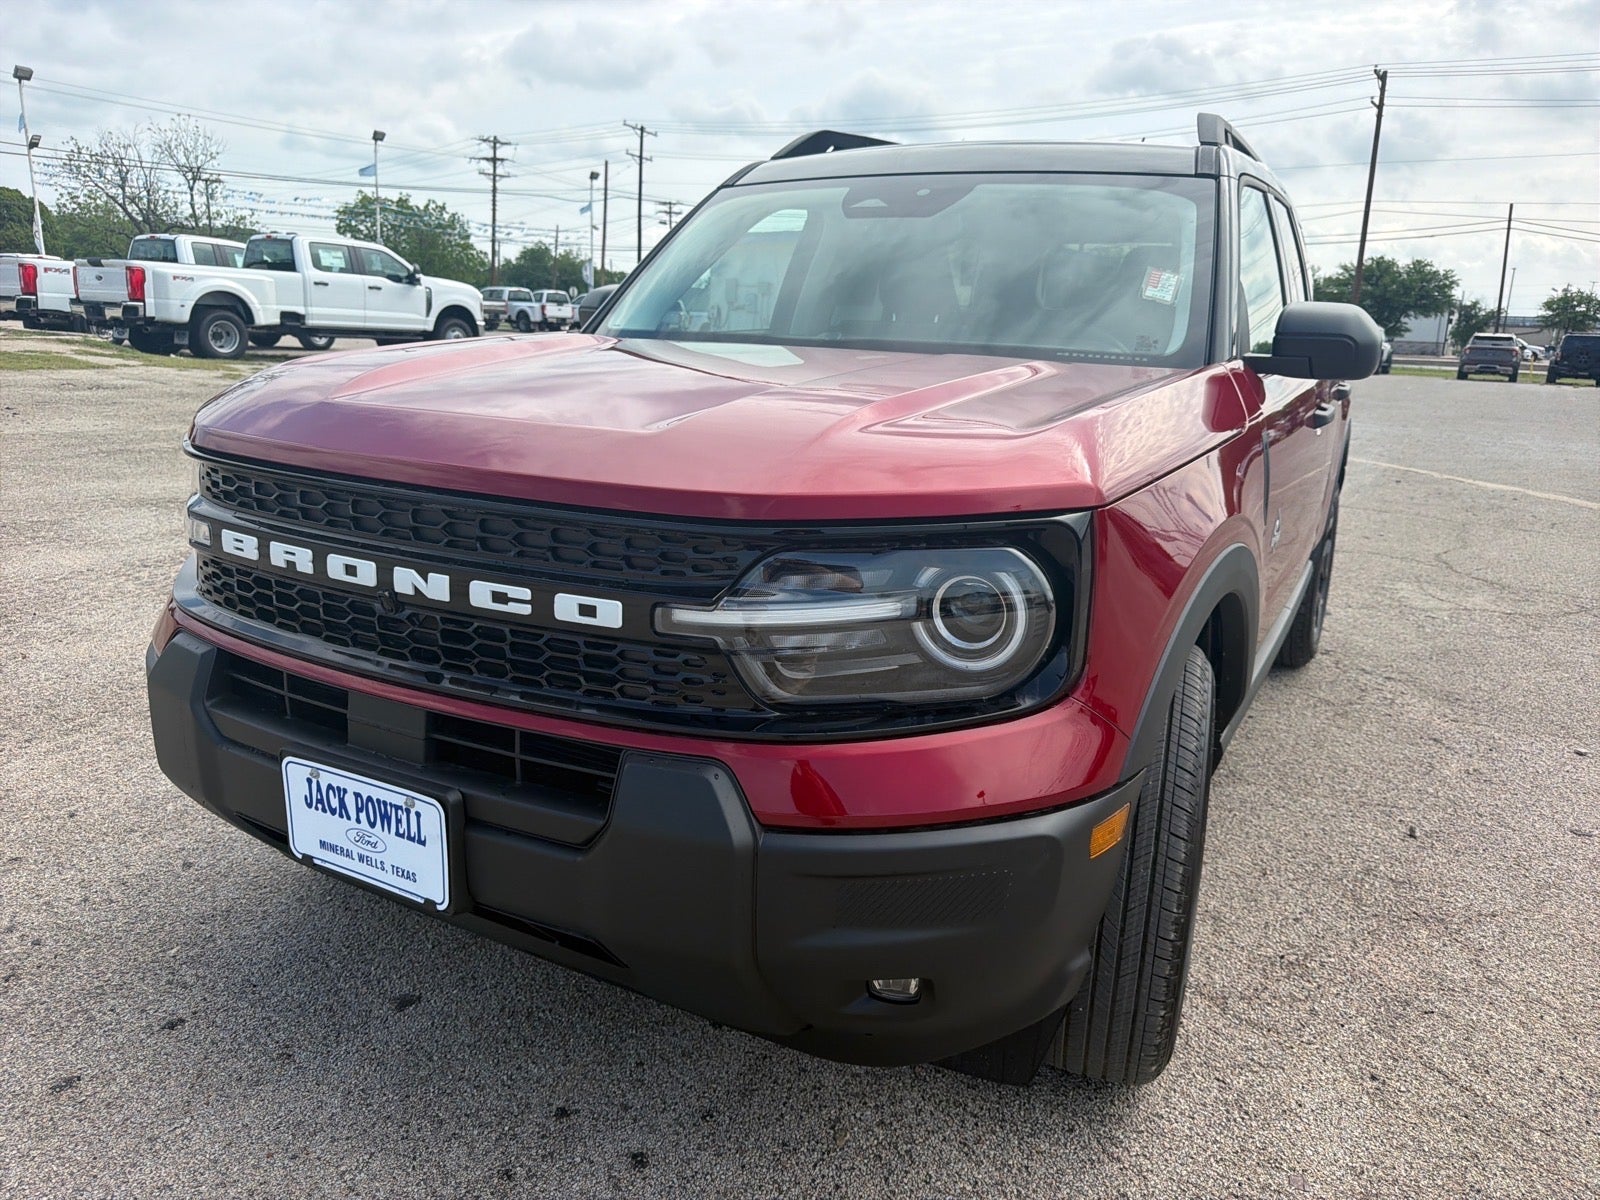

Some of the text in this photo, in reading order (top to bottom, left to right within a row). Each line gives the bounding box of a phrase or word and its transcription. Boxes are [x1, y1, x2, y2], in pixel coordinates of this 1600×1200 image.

[221, 529, 623, 629] BRONCO
[304, 777, 427, 848] JACK POWELL
[353, 830, 379, 850] Ford
[319, 839, 417, 883] MINERAL WELLS, TEXAS
